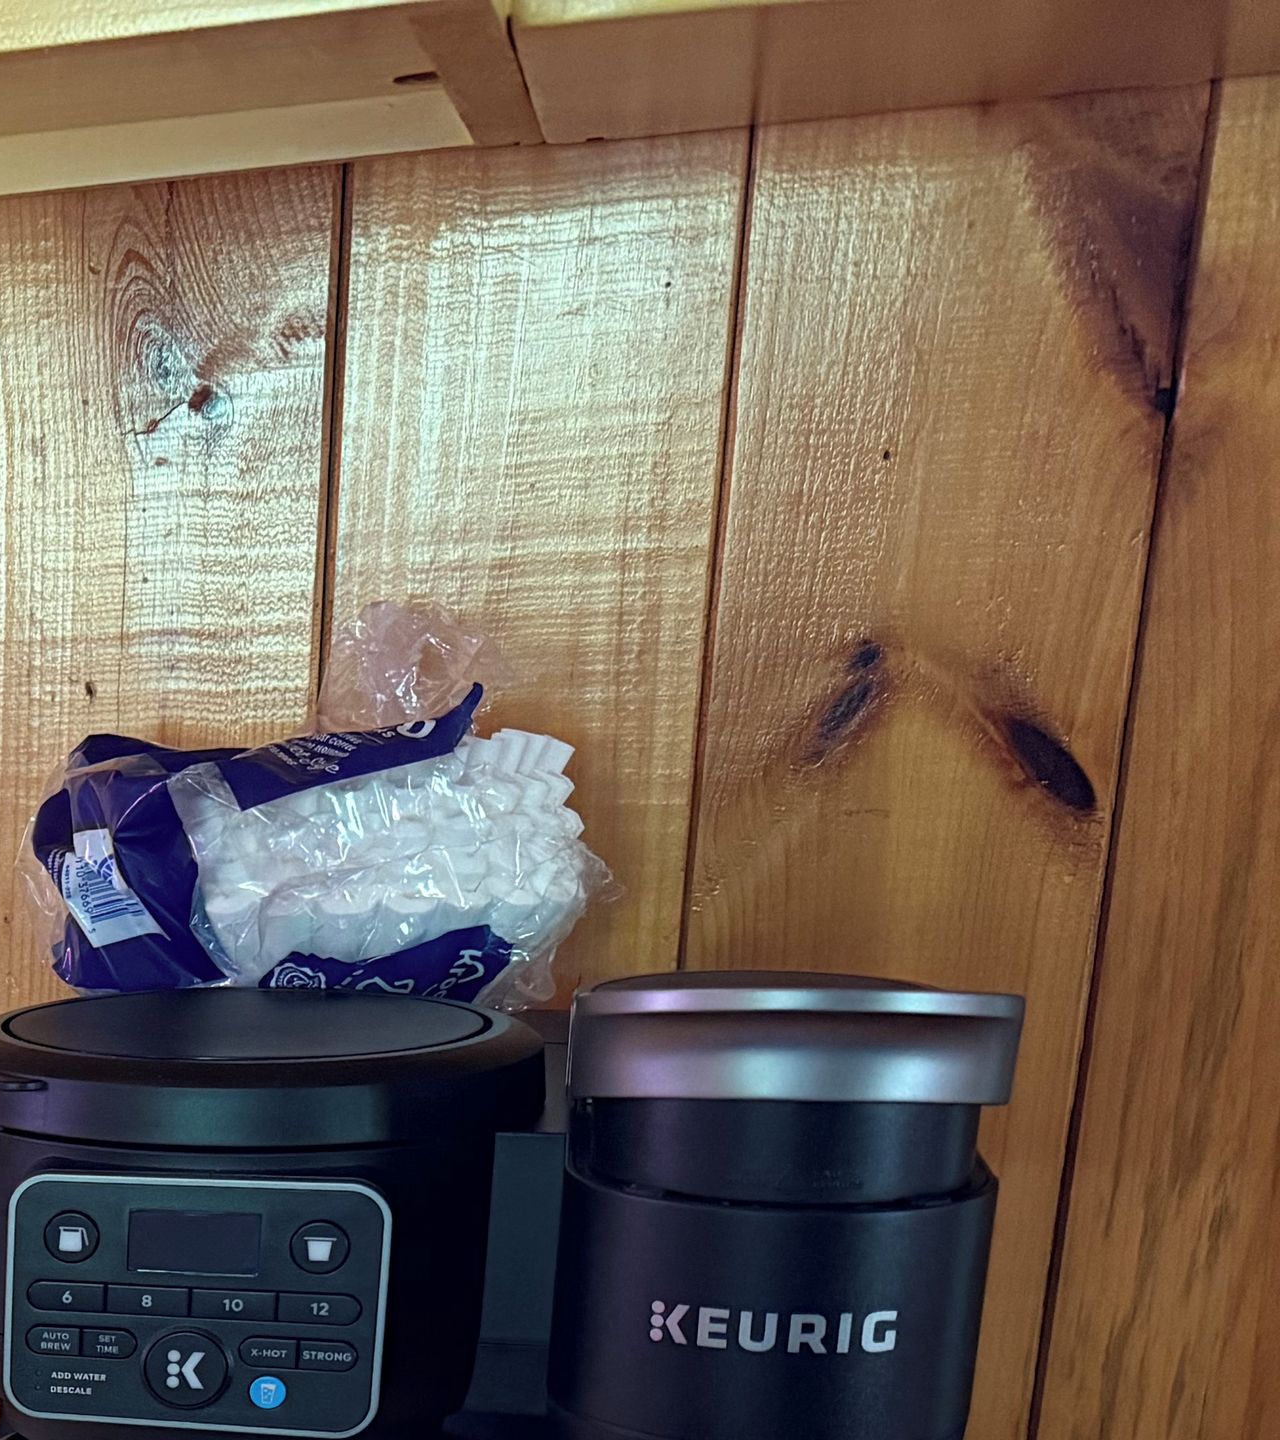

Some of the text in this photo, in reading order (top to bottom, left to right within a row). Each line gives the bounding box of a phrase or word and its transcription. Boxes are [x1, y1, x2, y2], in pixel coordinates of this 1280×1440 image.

[61, 1290, 73, 1305] 6
[141, 1295, 152, 1310] 8
[222, 1298, 244, 1313] 10
[310, 1302, 330, 1317] 12
[649, 1300, 898, 1354] KEURIG
[42, 1331, 70, 1341] AUTO
[98, 1334, 117, 1344] SET
[40, 1341, 71, 1352] BREW
[96, 1345, 119, 1355] TIME
[250, 1347, 288, 1360] X-HOT
[302, 1349, 352, 1363] STRONG
[51, 1371, 107, 1382] ADD WATER
[50, 1385, 92, 1395] DESCALE
